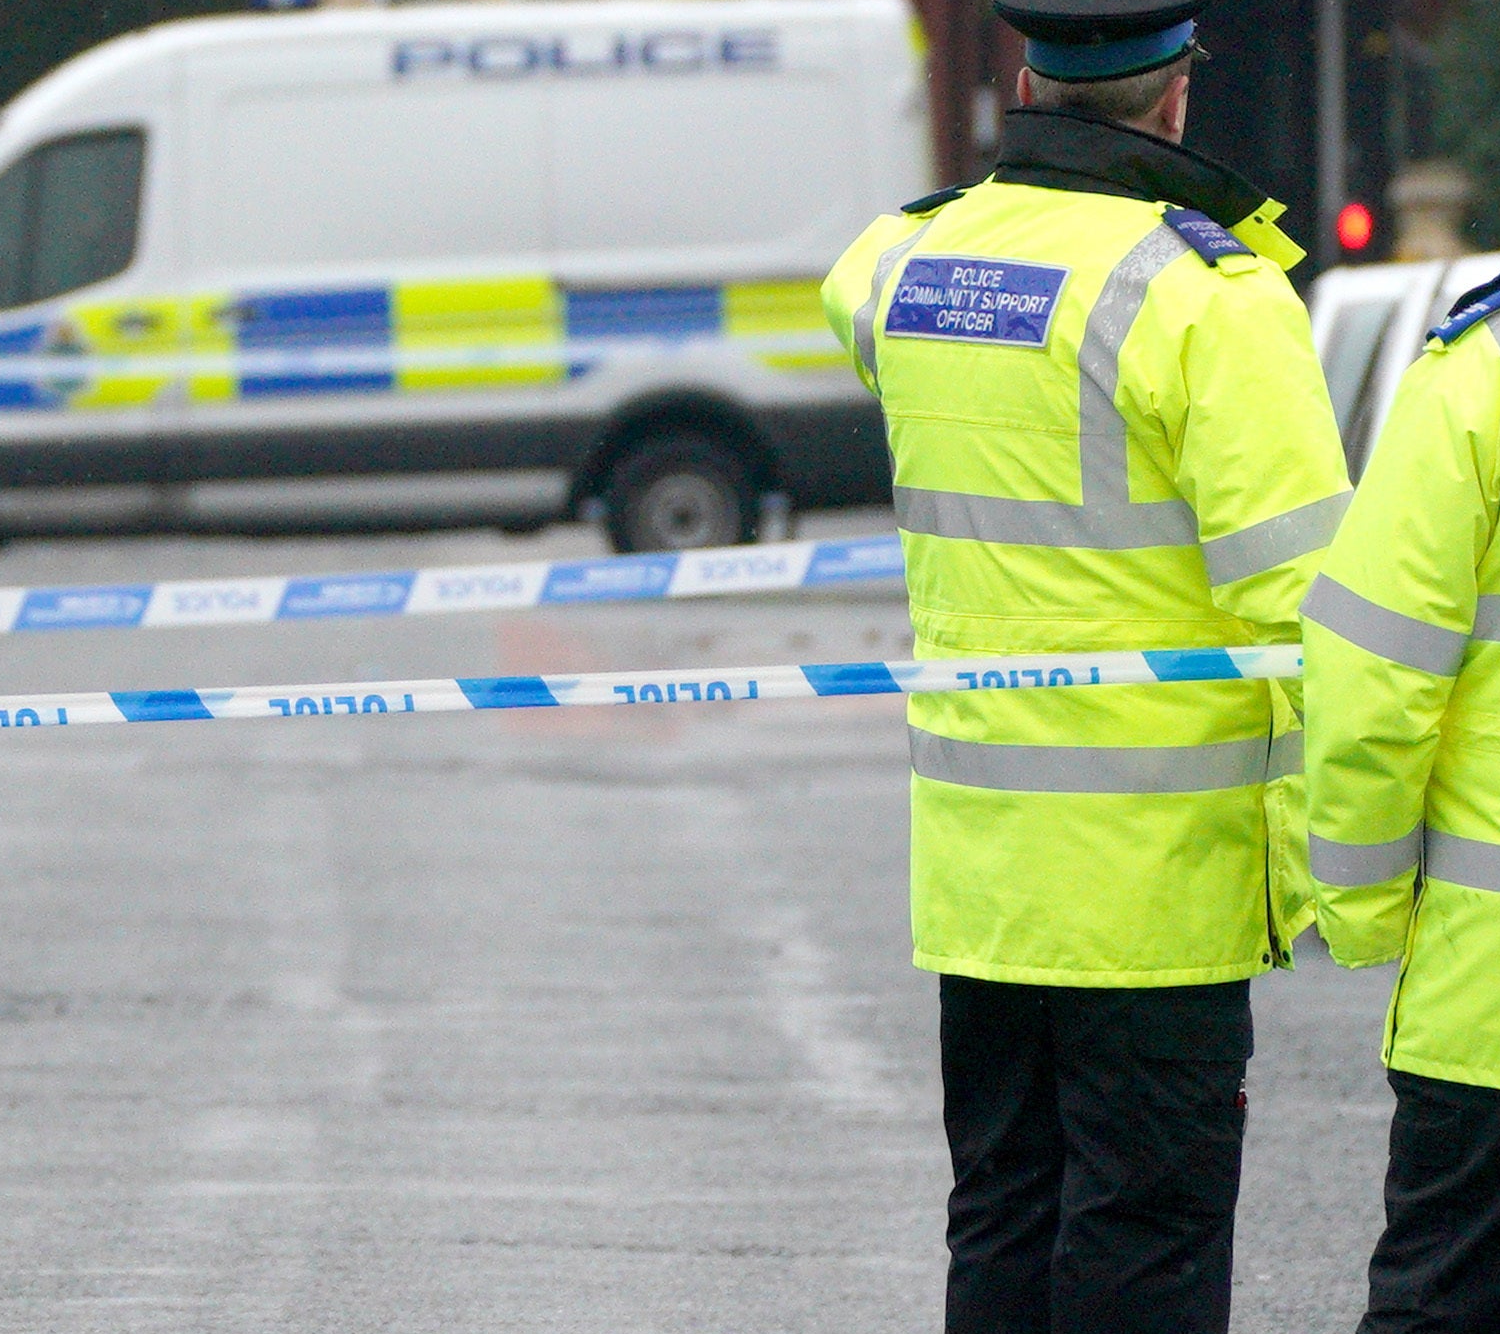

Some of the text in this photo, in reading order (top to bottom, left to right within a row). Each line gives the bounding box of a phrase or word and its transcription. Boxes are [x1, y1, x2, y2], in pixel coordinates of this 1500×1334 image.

[388, 26, 783, 80] POLICE
[951, 267, 1004, 287] POLICE
[898, 286, 1050, 314] COMMUNITY SUPPORT
[936, 311, 995, 331] OFFICER
